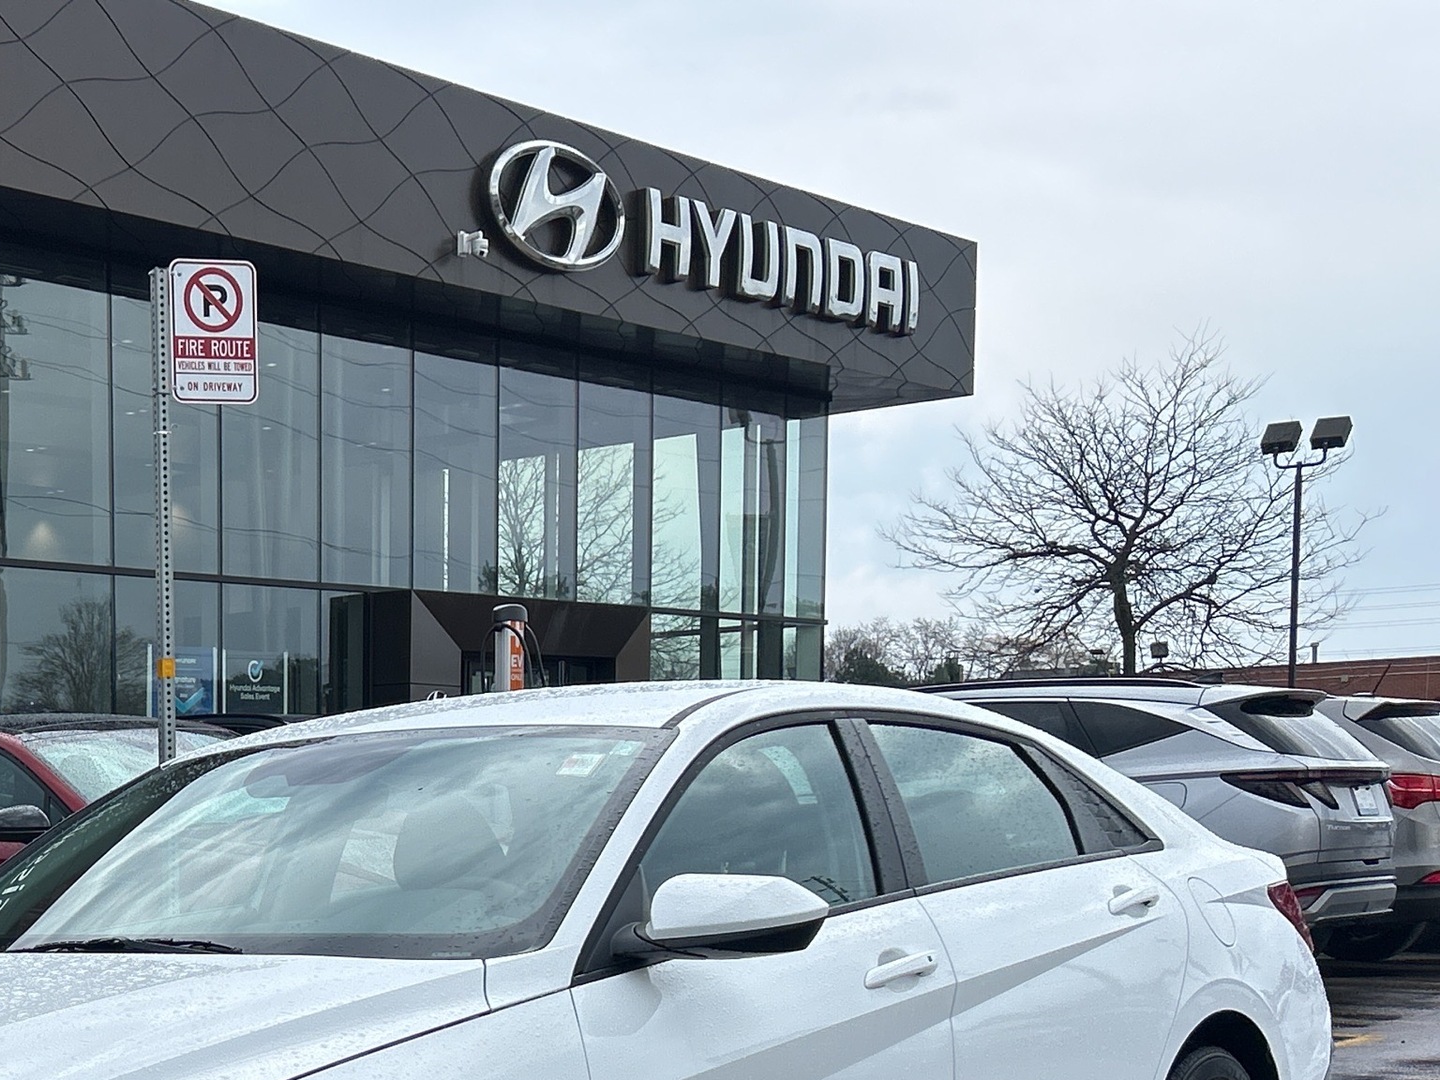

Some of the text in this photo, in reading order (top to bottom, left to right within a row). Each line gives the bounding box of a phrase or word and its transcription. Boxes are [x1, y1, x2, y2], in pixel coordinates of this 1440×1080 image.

[643, 187, 920, 335] HYUNDAI
[178, 339, 251, 357] FIRE ROUTE
[178, 361, 252, 372] VEHICLES WILL BE TOWED
[187, 381, 243, 392] ON DRIVEWAY
[511, 655, 524, 669] EV
[229, 684, 280, 693] Hyundai Advantage
